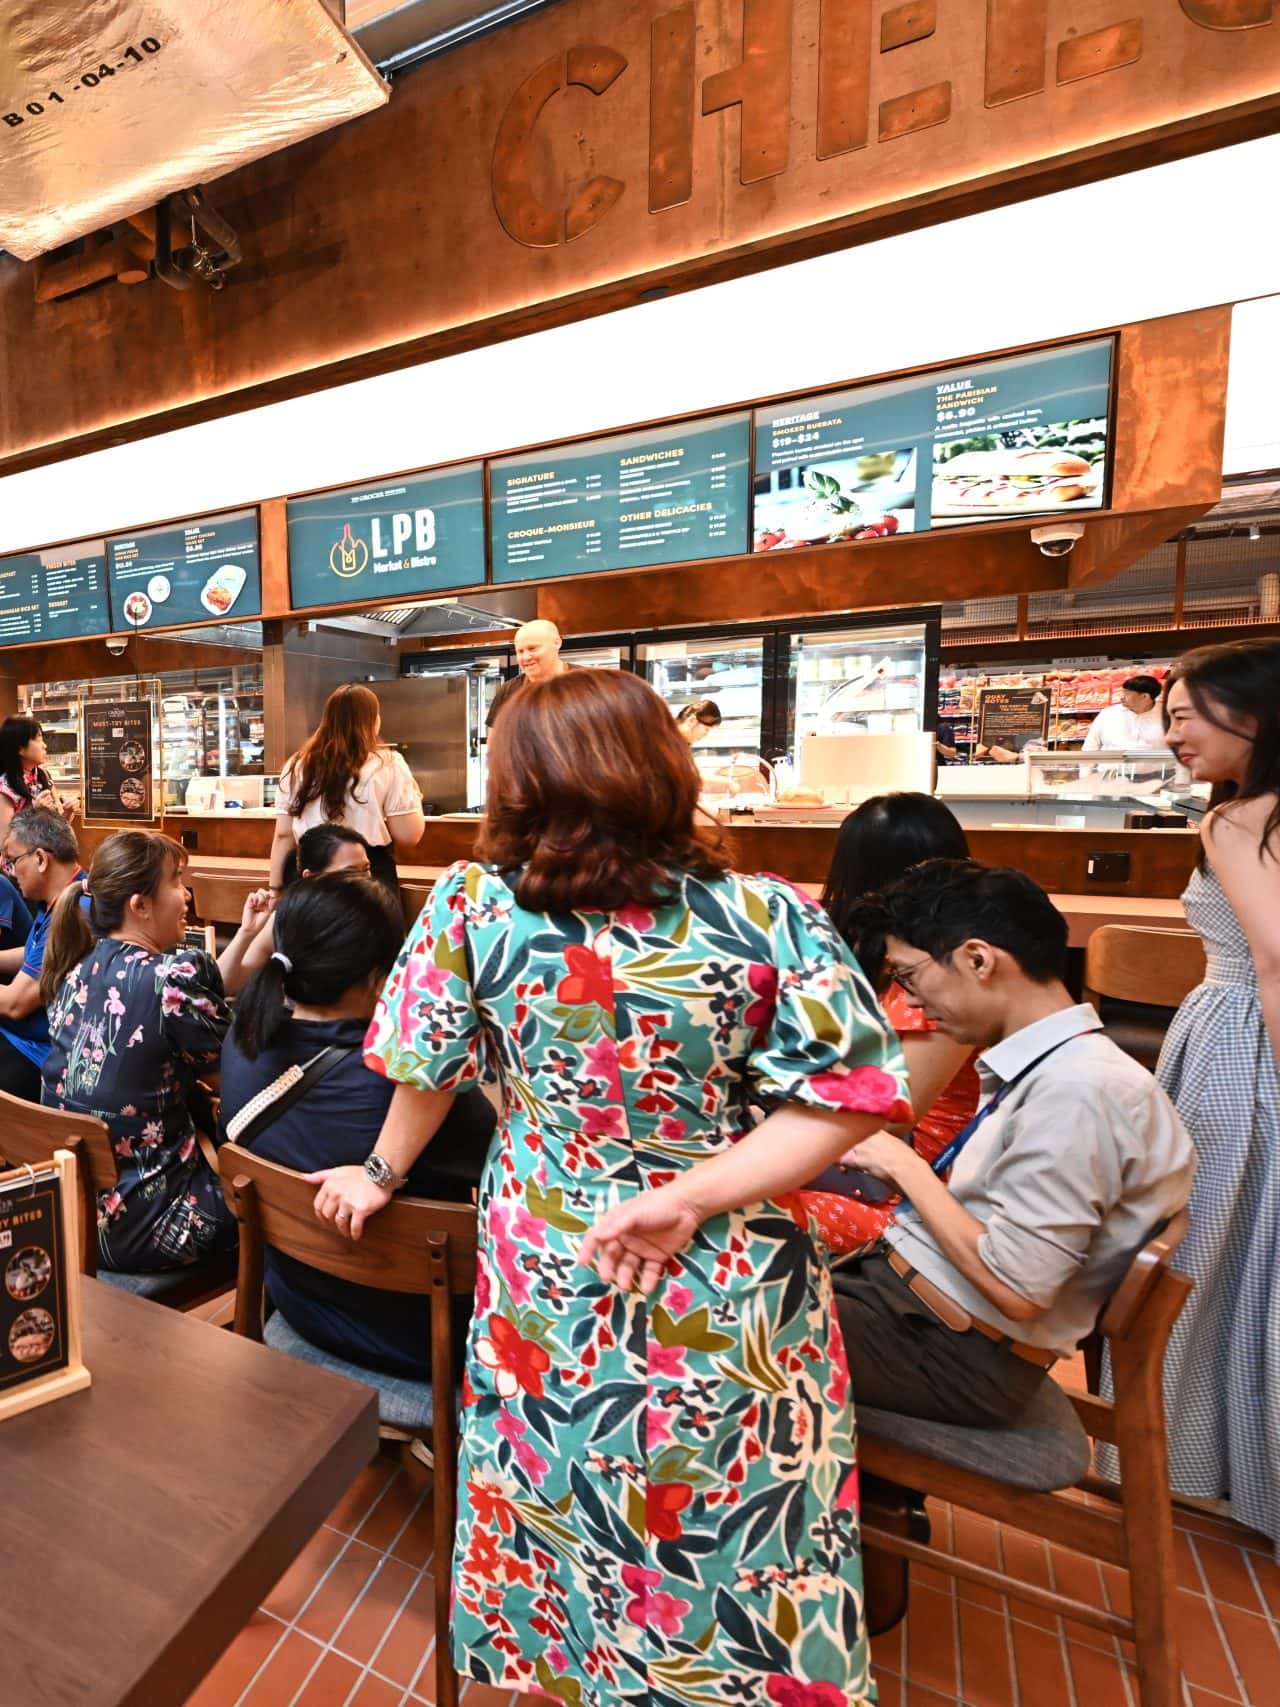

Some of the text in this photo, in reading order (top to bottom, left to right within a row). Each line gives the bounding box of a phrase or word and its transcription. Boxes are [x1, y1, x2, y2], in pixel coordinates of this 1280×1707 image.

[936, 380, 972, 394] VALUE
[936, 397, 984, 410] SANDWICH
[772, 411, 820, 428] HERITAGE
[937, 407, 976, 422] $6.90
[620, 448, 685, 466] SANDWICHES
[507, 471, 555, 487] SIGNATURE
[620, 502, 713, 523] OTHER DELICACIES
[371, 508, 436, 558] LPB
[507, 520, 595, 539] CROQUE-MONSIEUR
[13, 1209, 42, 1225] BITES
